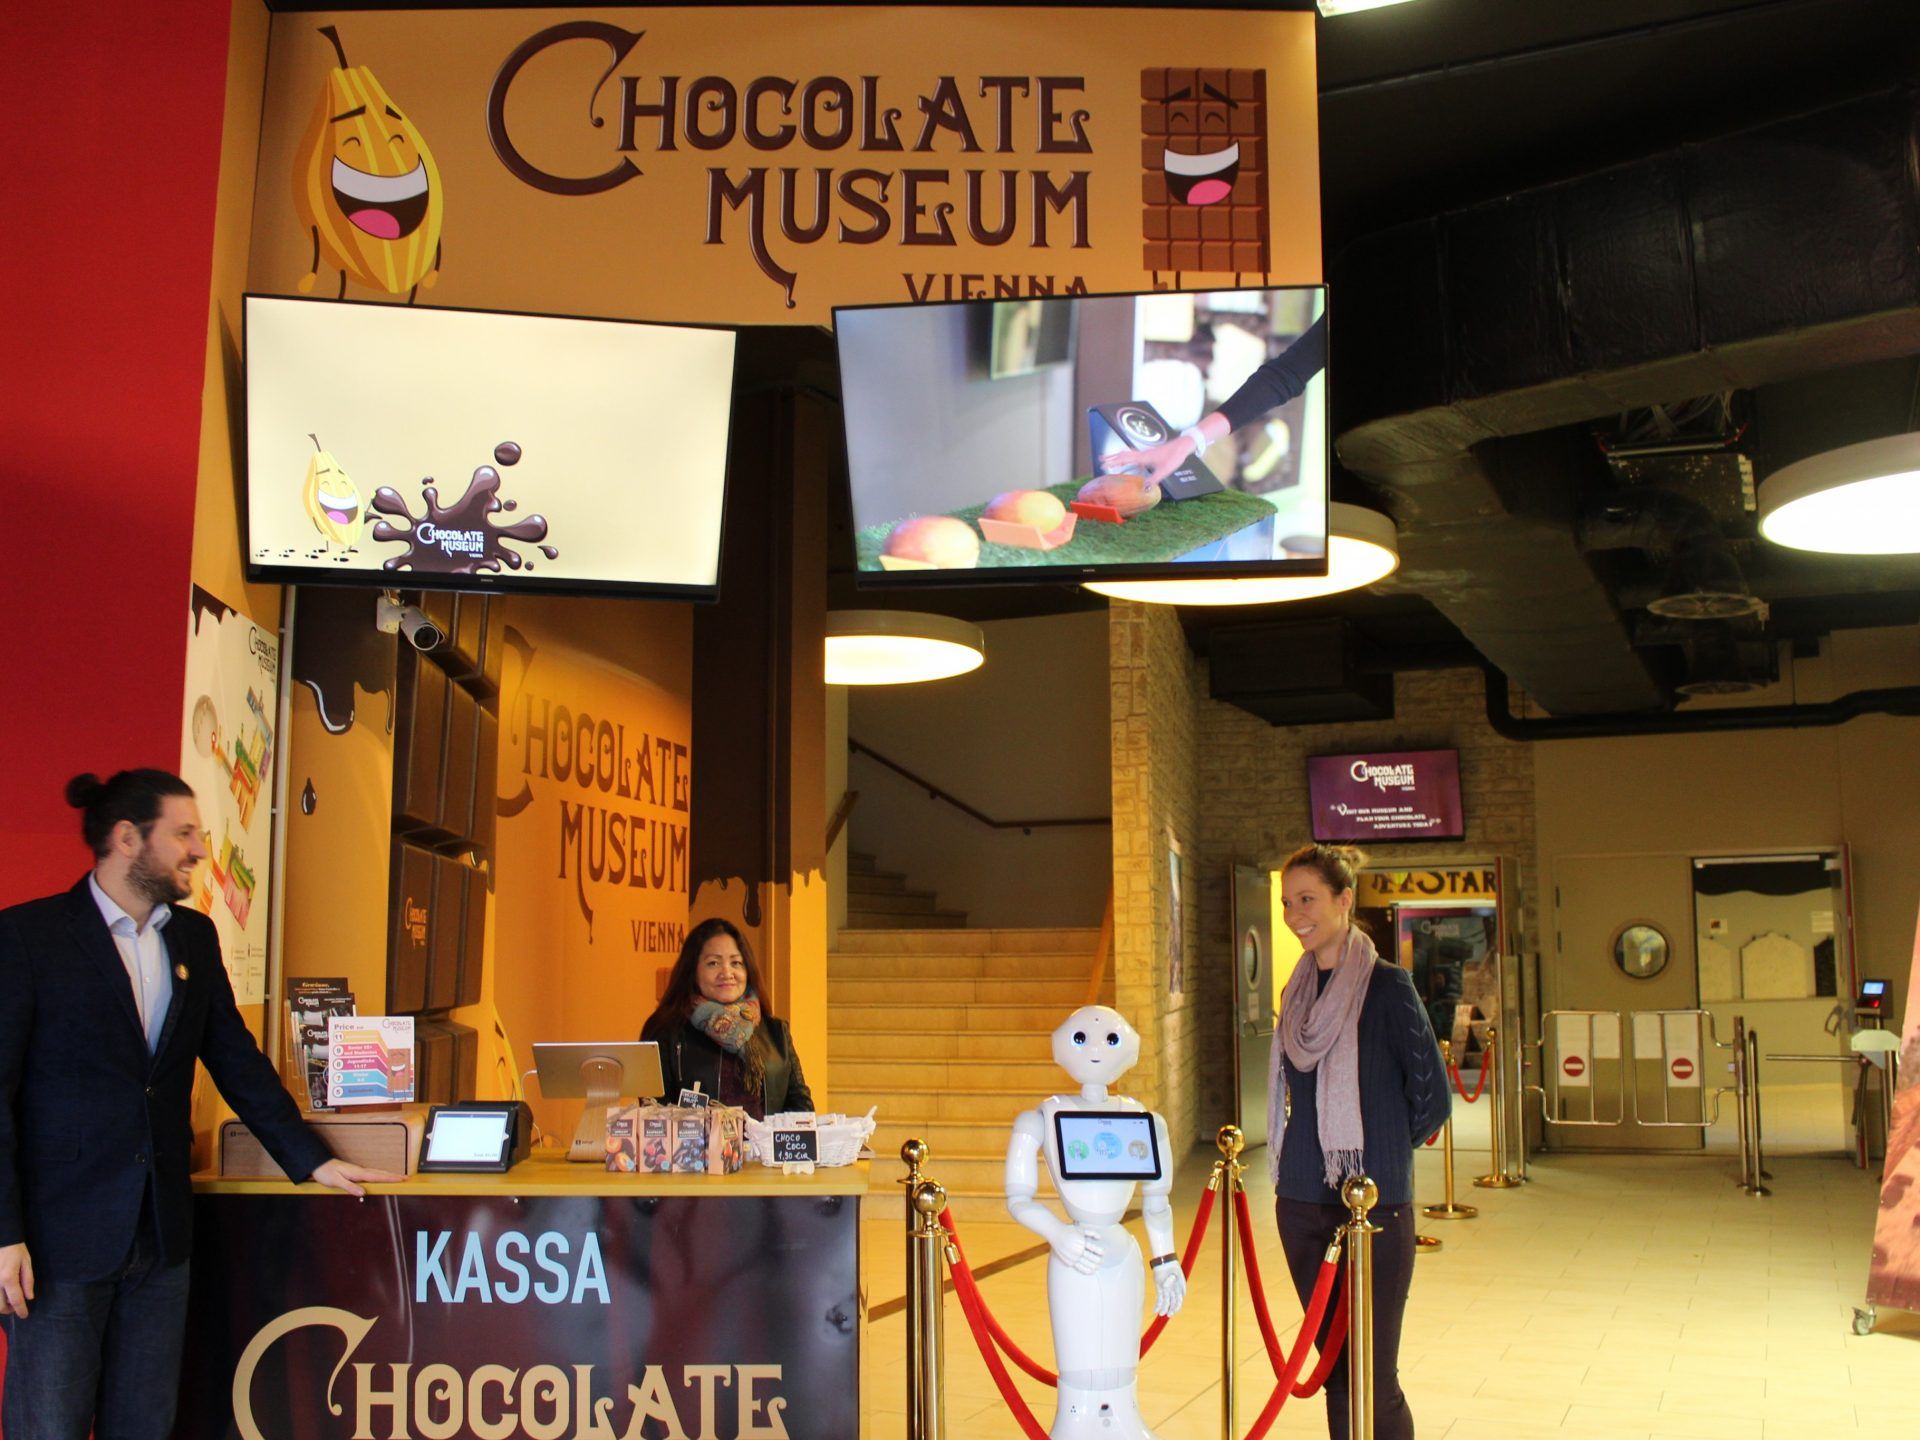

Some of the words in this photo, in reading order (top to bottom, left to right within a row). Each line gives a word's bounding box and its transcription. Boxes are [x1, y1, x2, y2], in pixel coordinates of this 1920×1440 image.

[486, 20, 1094, 196] CHOCOLATE
[703, 166, 1093, 310] MUSEUM
[416, 522, 485, 545] CHOCOLATE
[441, 540, 484, 558] MUSEUM
[1350, 760, 1414, 783] CHOCOLATE
[1374, 775, 1415, 792] MUSEUM
[558, 799, 688, 945] MUSEUM
[631, 919, 686, 953] VIENNA
[775, 1133, 800, 1143] CHOCO
[785, 1142, 807, 1151] COCO
[416, 1231, 611, 1304] KASSA
[232, 1306, 788, 1440] CHOCOLATE
